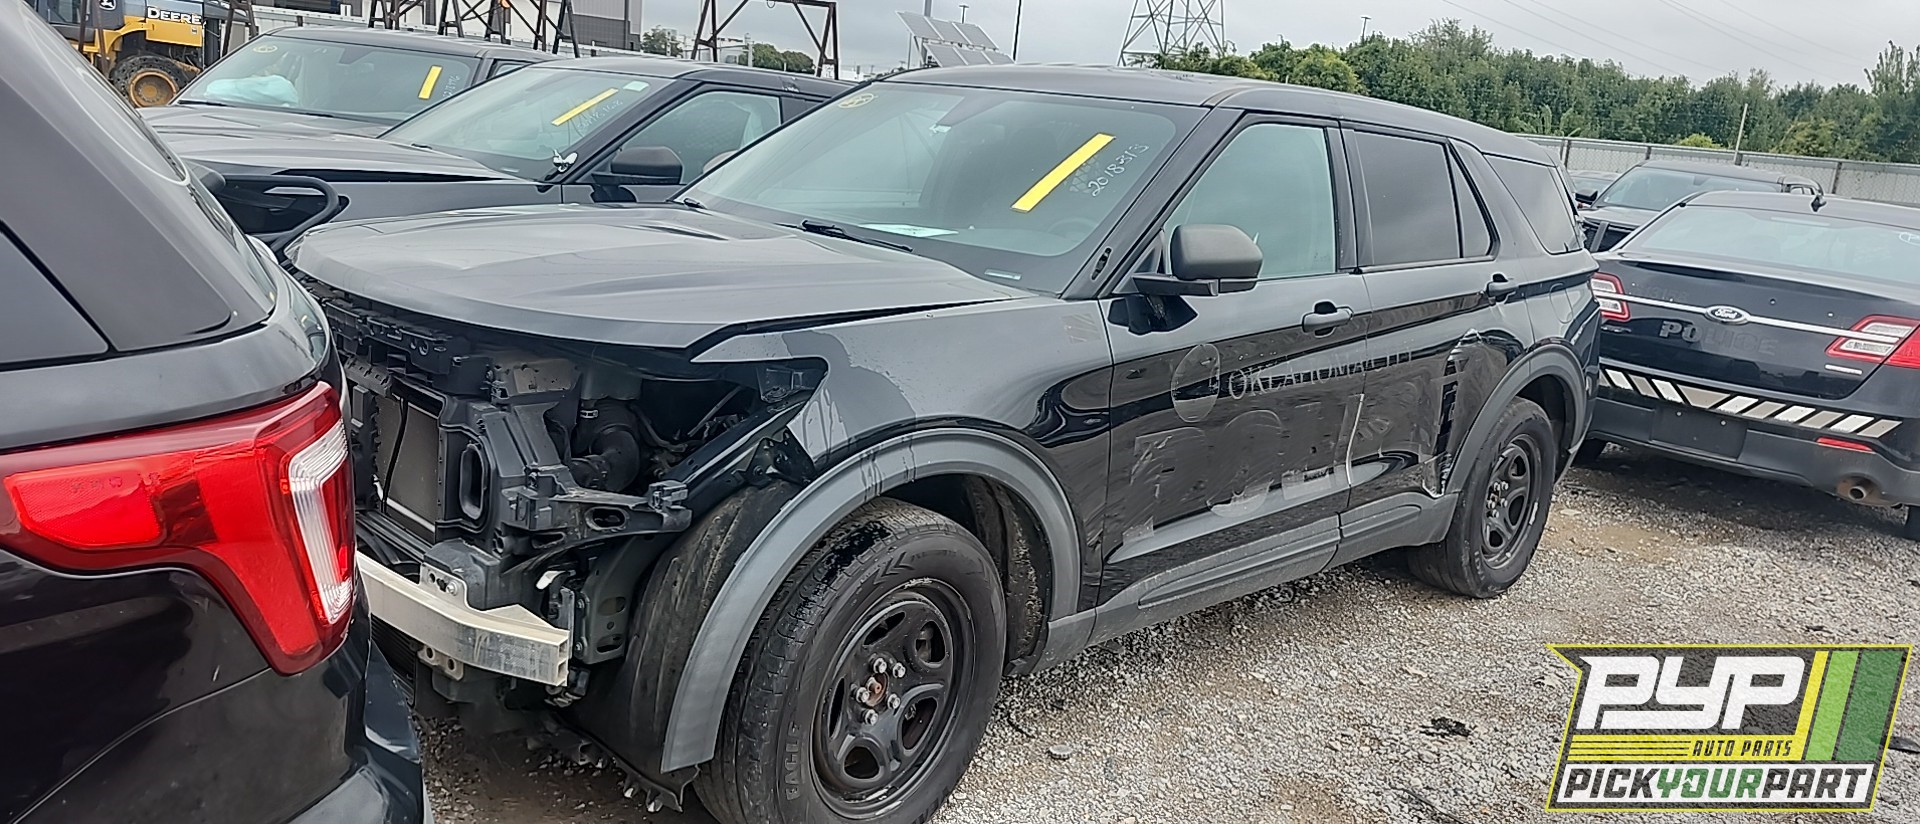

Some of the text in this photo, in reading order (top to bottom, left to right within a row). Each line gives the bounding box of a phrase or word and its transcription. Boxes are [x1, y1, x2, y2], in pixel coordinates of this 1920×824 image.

[147, 6, 203, 25] DEERE
[1714, 307, 1738, 319] Ford
[1658, 319, 1779, 356] POLICE
[784, 721, 800, 801] EAGLE
